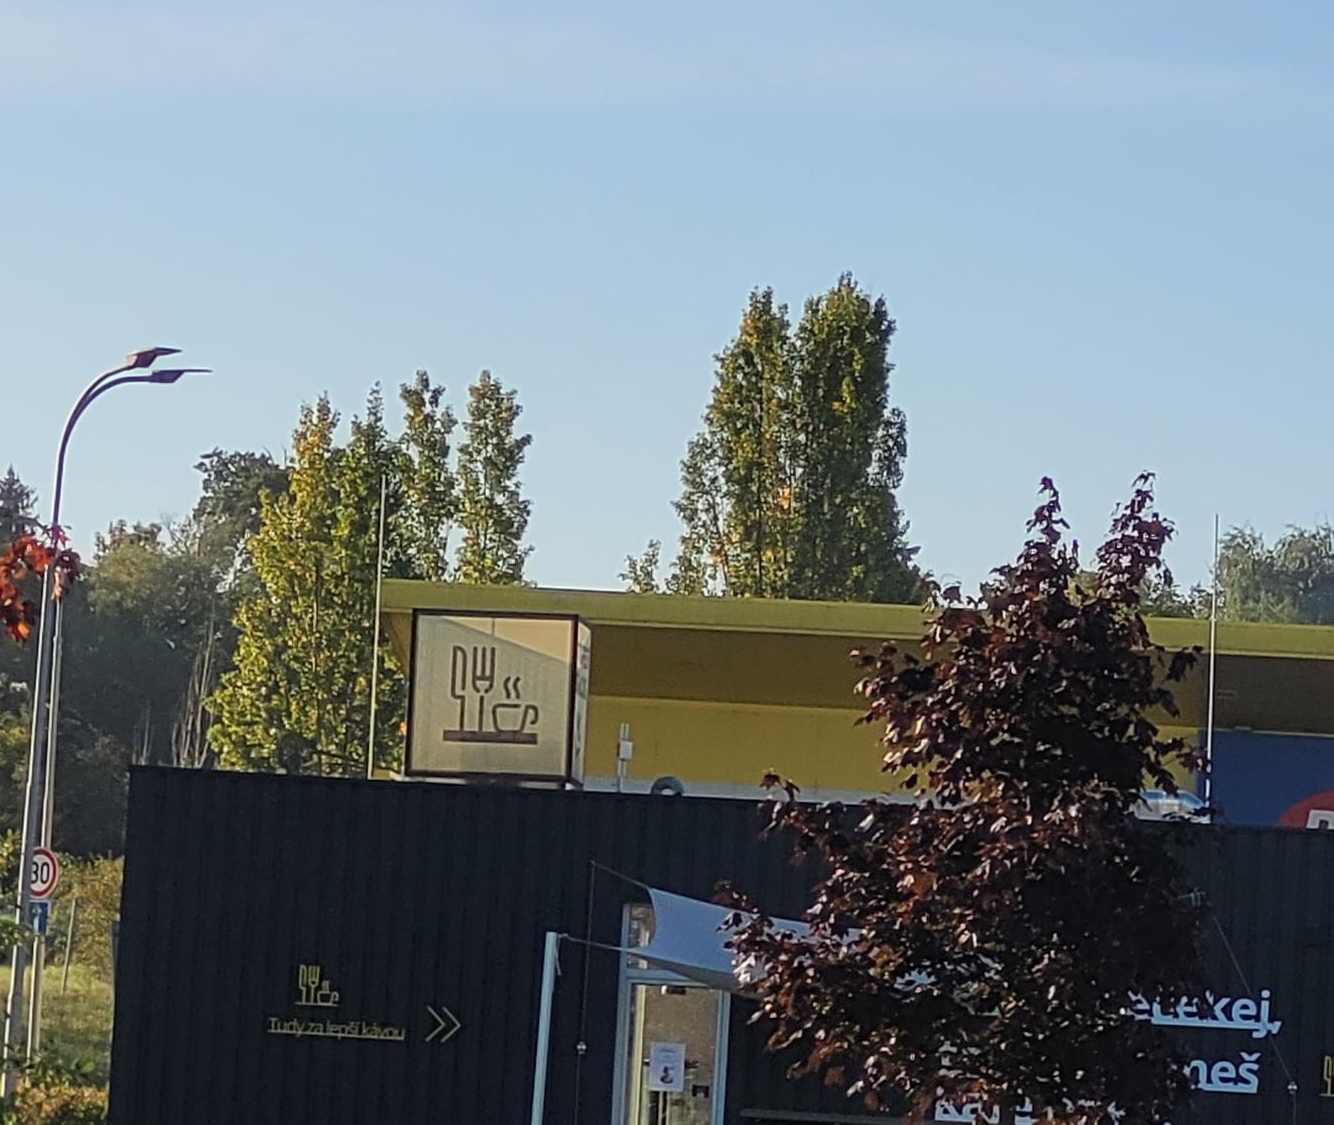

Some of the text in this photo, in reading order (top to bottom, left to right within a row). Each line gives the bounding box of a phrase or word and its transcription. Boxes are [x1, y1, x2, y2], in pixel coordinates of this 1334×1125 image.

[31, 861, 50, 885] 30
[268, 1017, 305, 1038] Tudy
[306, 1022, 324, 1035] za
[362, 1021, 405, 1040] kávou
